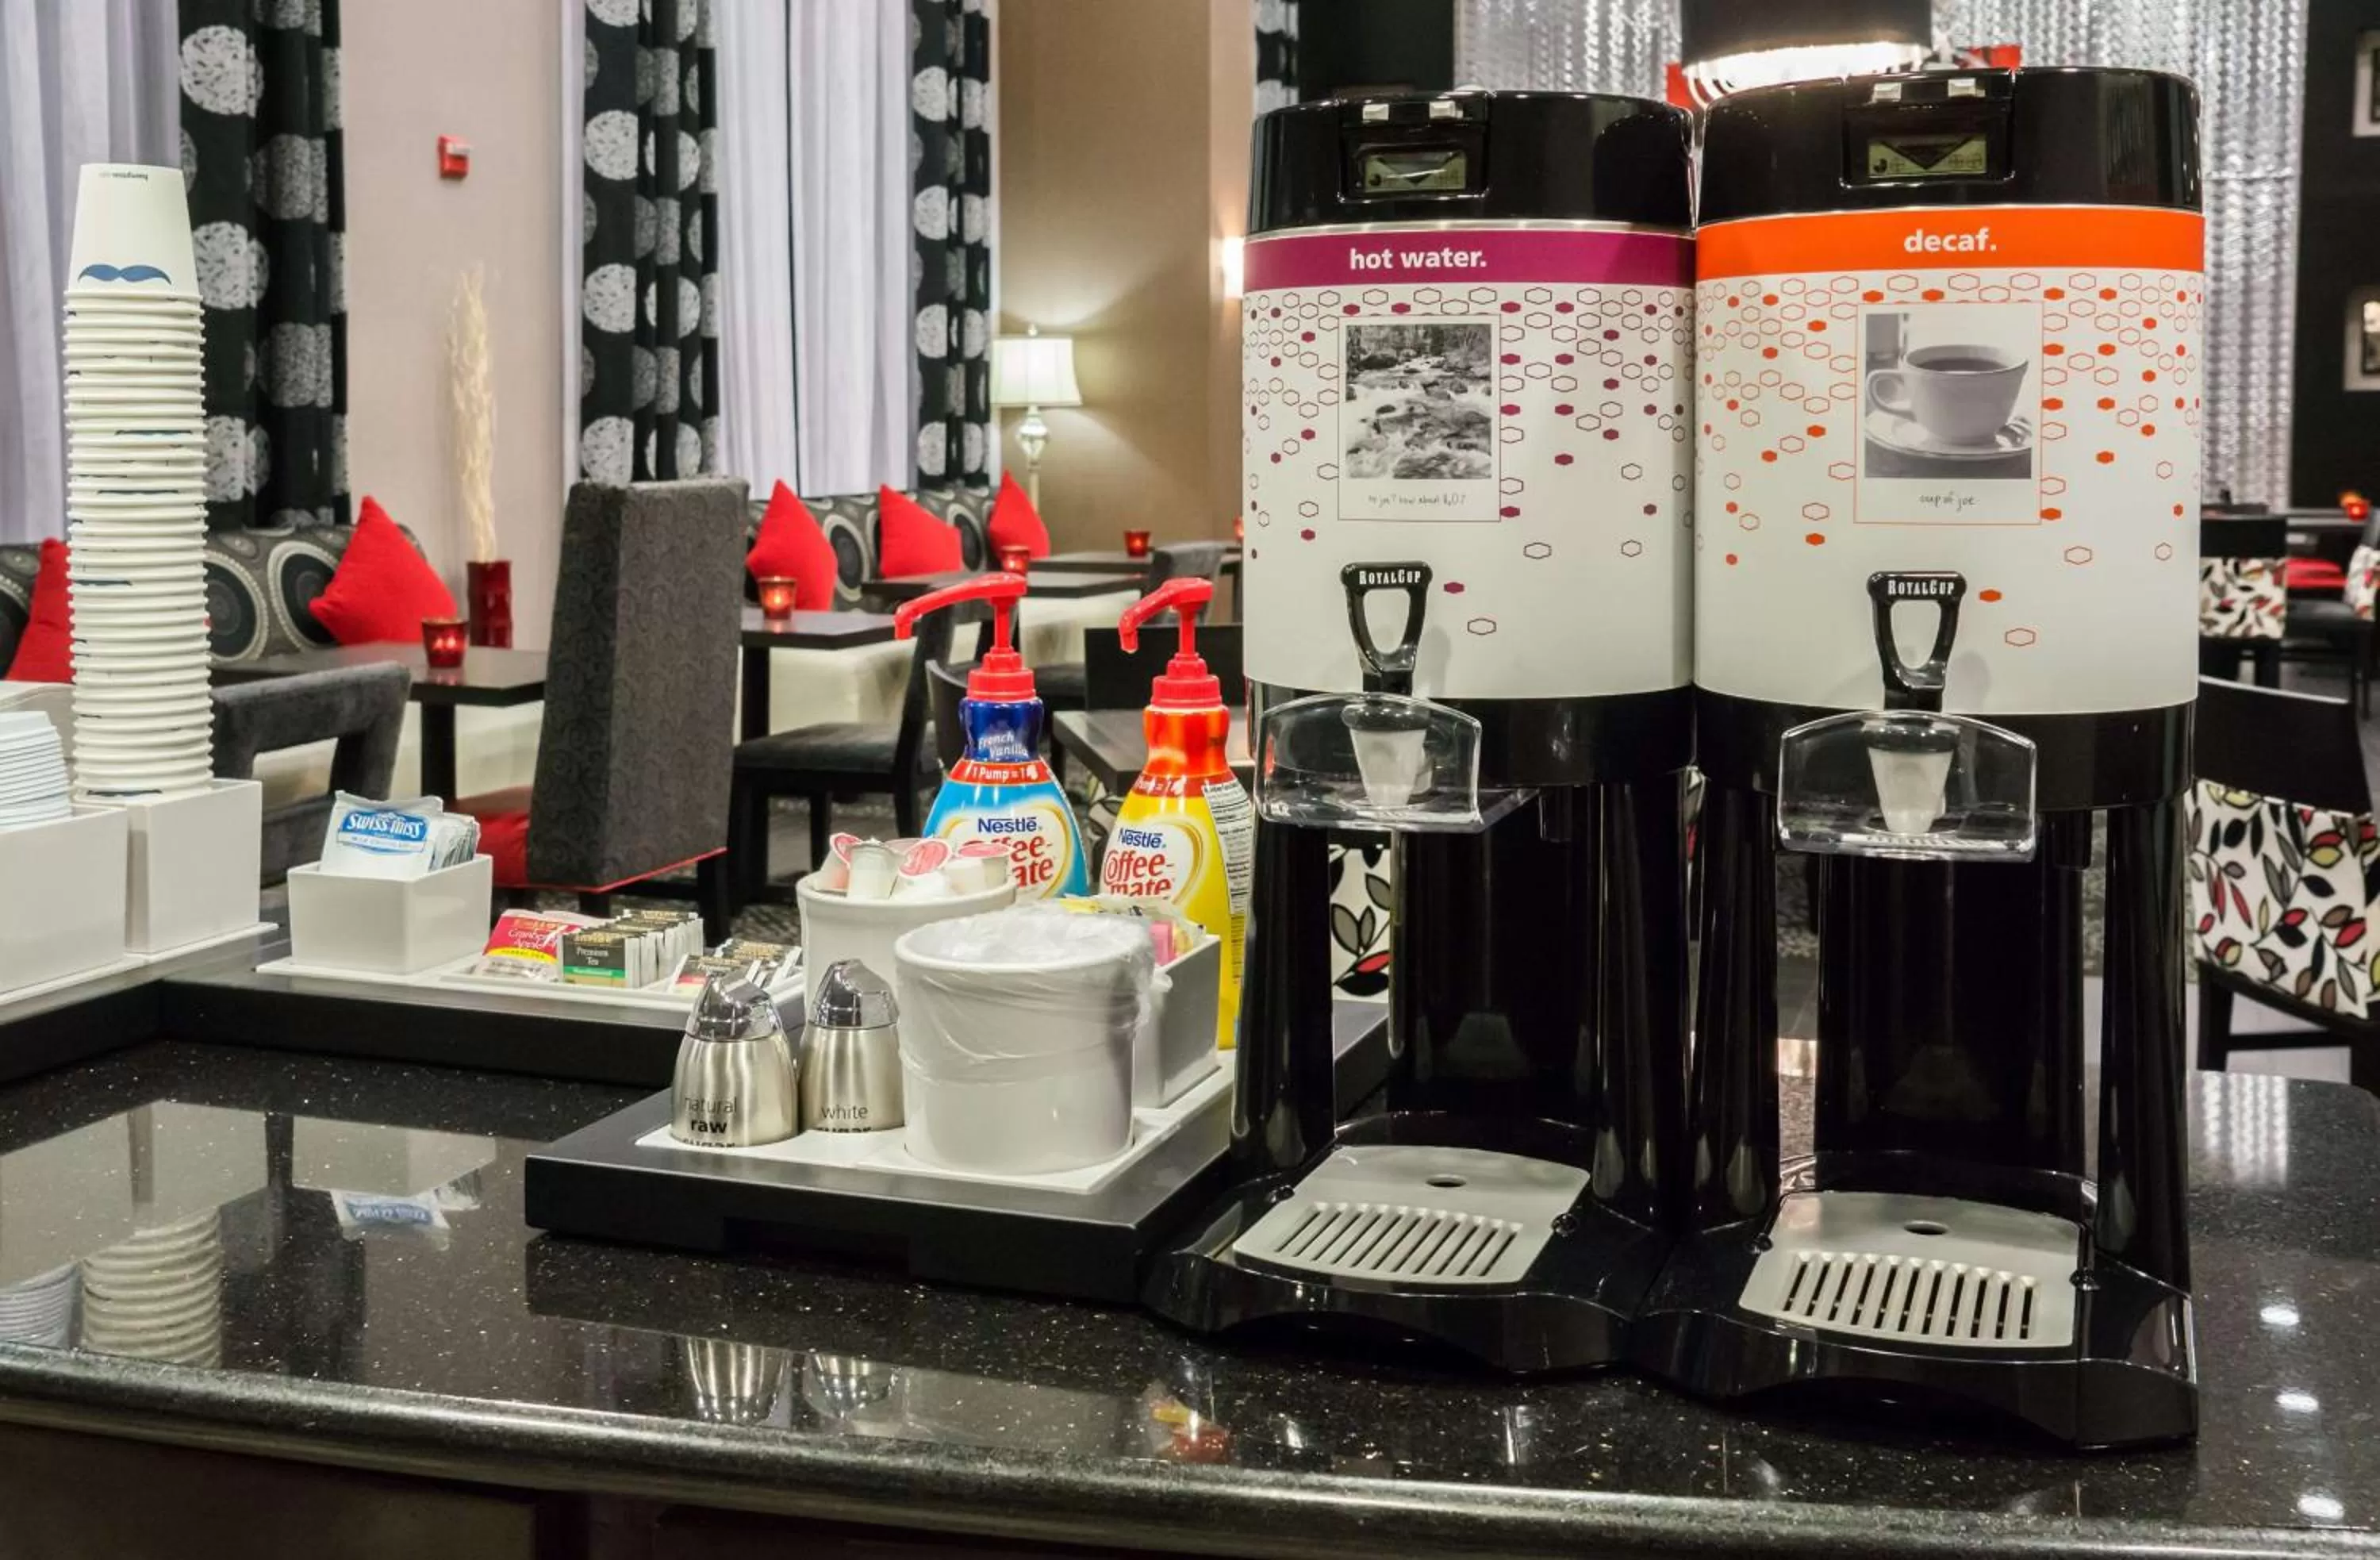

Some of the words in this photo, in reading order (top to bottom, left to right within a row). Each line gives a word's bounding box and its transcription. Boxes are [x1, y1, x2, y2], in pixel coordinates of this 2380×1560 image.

[1904, 226, 1997, 252] decaf.
[1350, 248, 1393, 270] hot
[1400, 247, 1488, 268] water.
[978, 731, 1015, 750] French
[979, 767, 1009, 782] Pump
[1012, 858, 1054, 888] ate
[820, 1104, 869, 1120] white
[691, 1119, 727, 1134] raw
